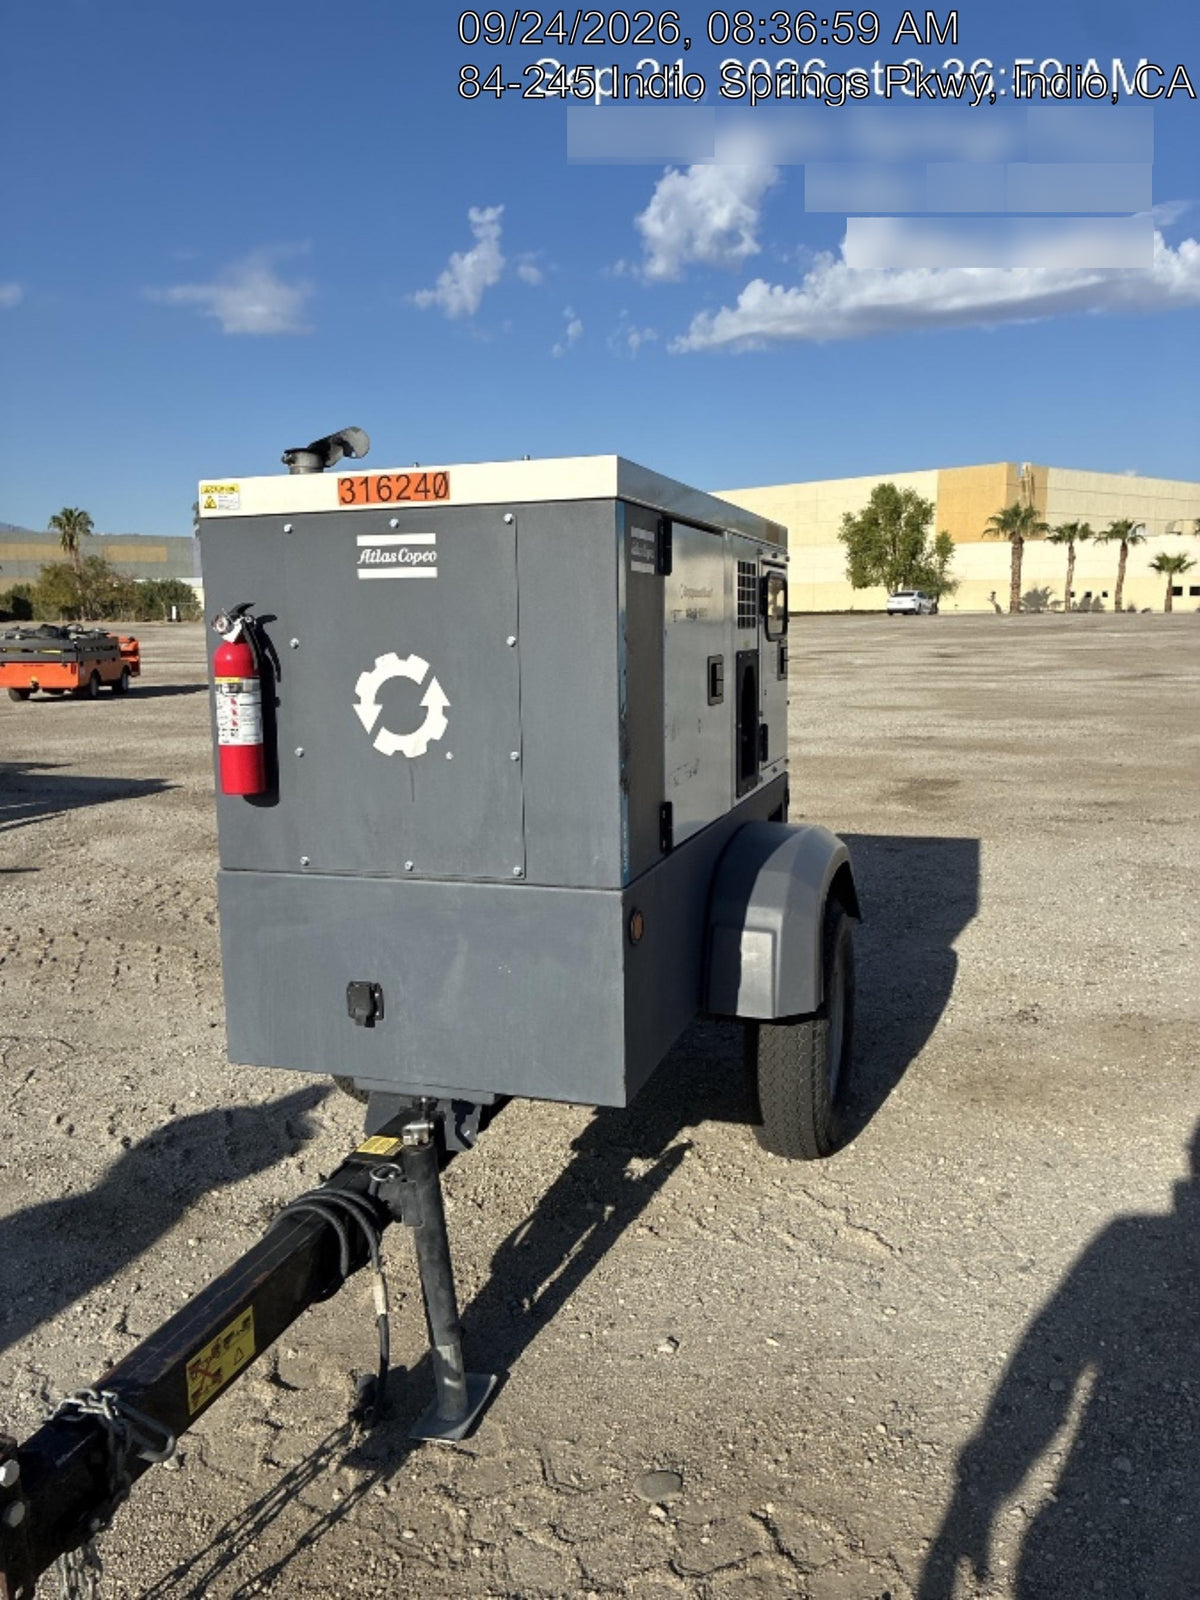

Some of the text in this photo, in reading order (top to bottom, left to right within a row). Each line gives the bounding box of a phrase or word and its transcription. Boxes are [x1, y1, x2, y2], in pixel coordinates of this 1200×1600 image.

[340, 472, 449, 503] 316240
[356, 547, 437, 565] Atlas Copco
